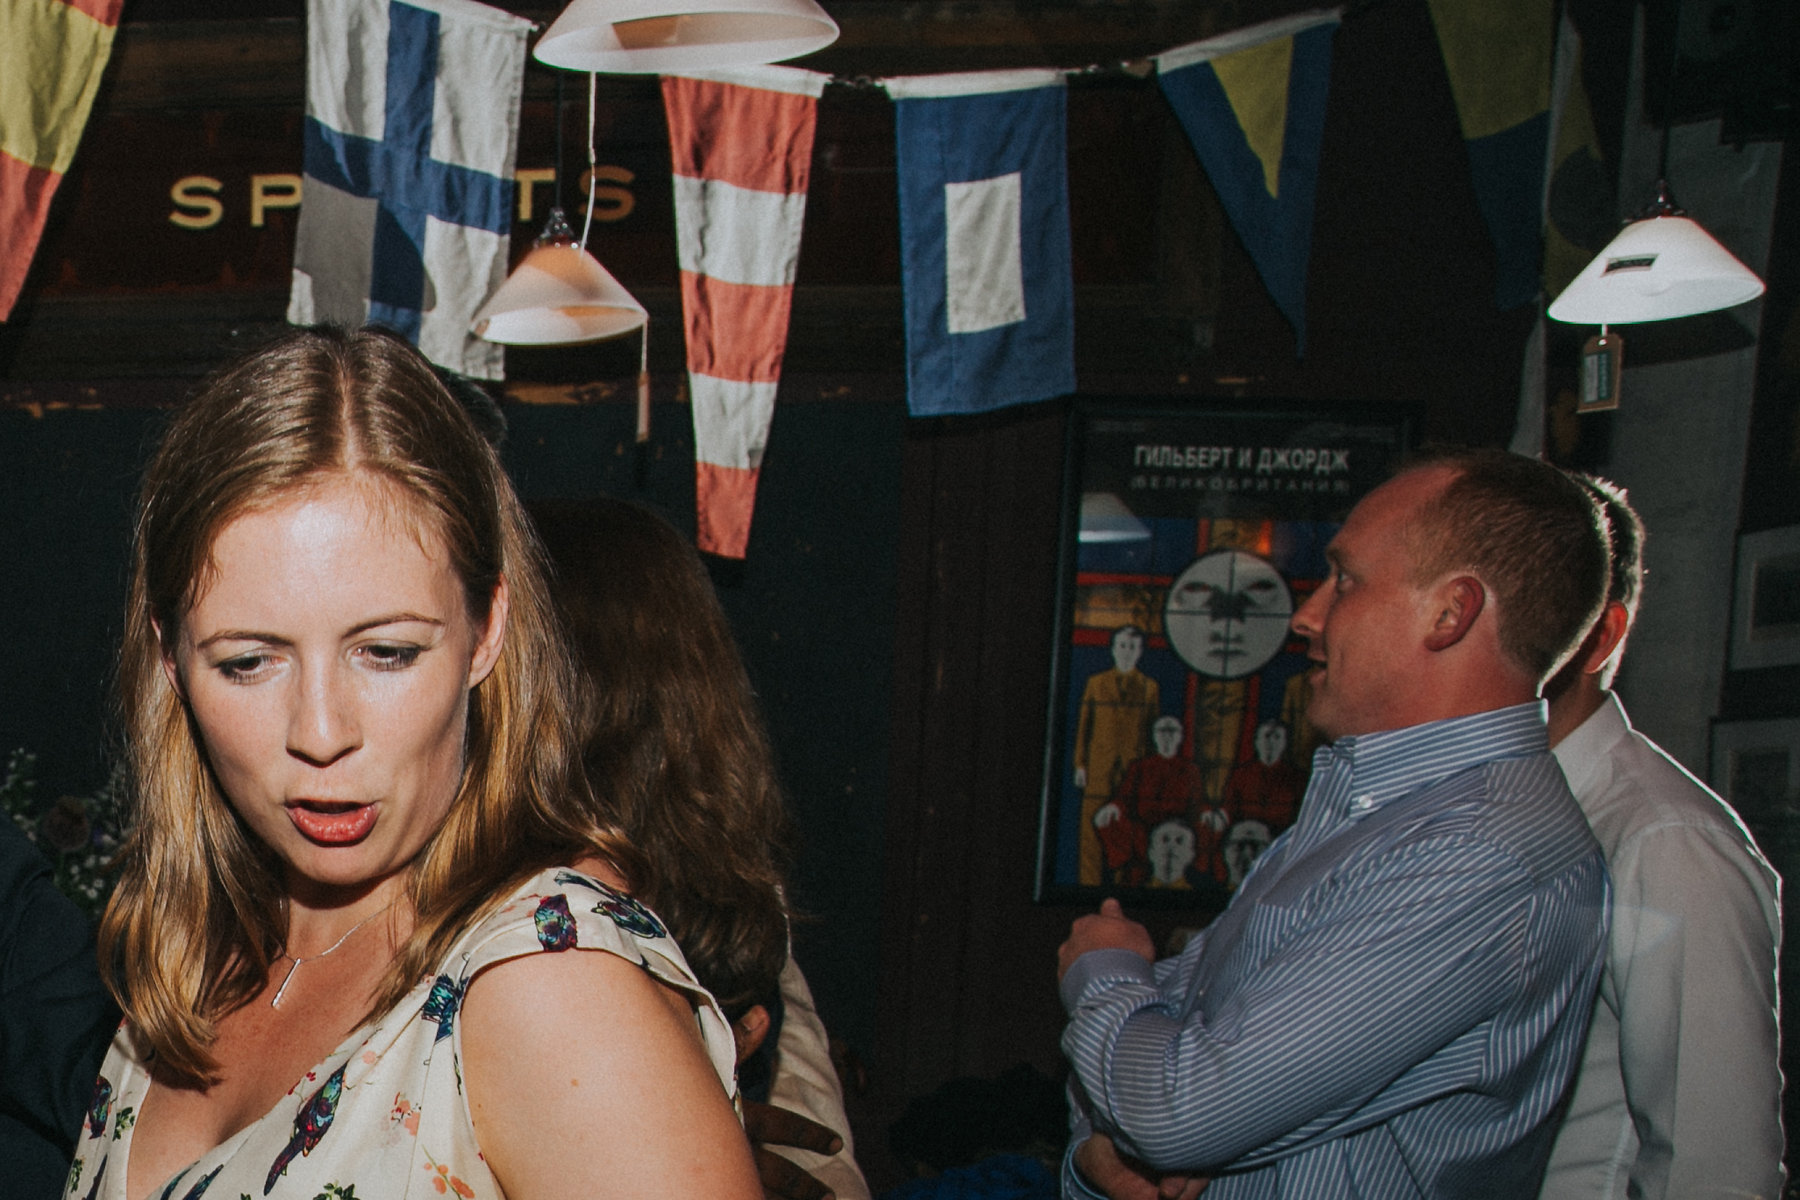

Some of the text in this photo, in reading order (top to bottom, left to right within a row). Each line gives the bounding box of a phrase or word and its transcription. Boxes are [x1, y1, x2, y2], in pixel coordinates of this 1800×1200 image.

[168, 165, 637, 230] SPTS
[1134, 445, 1350, 476] ГИЛЬБЕРТ И ДЖОРДЖ
